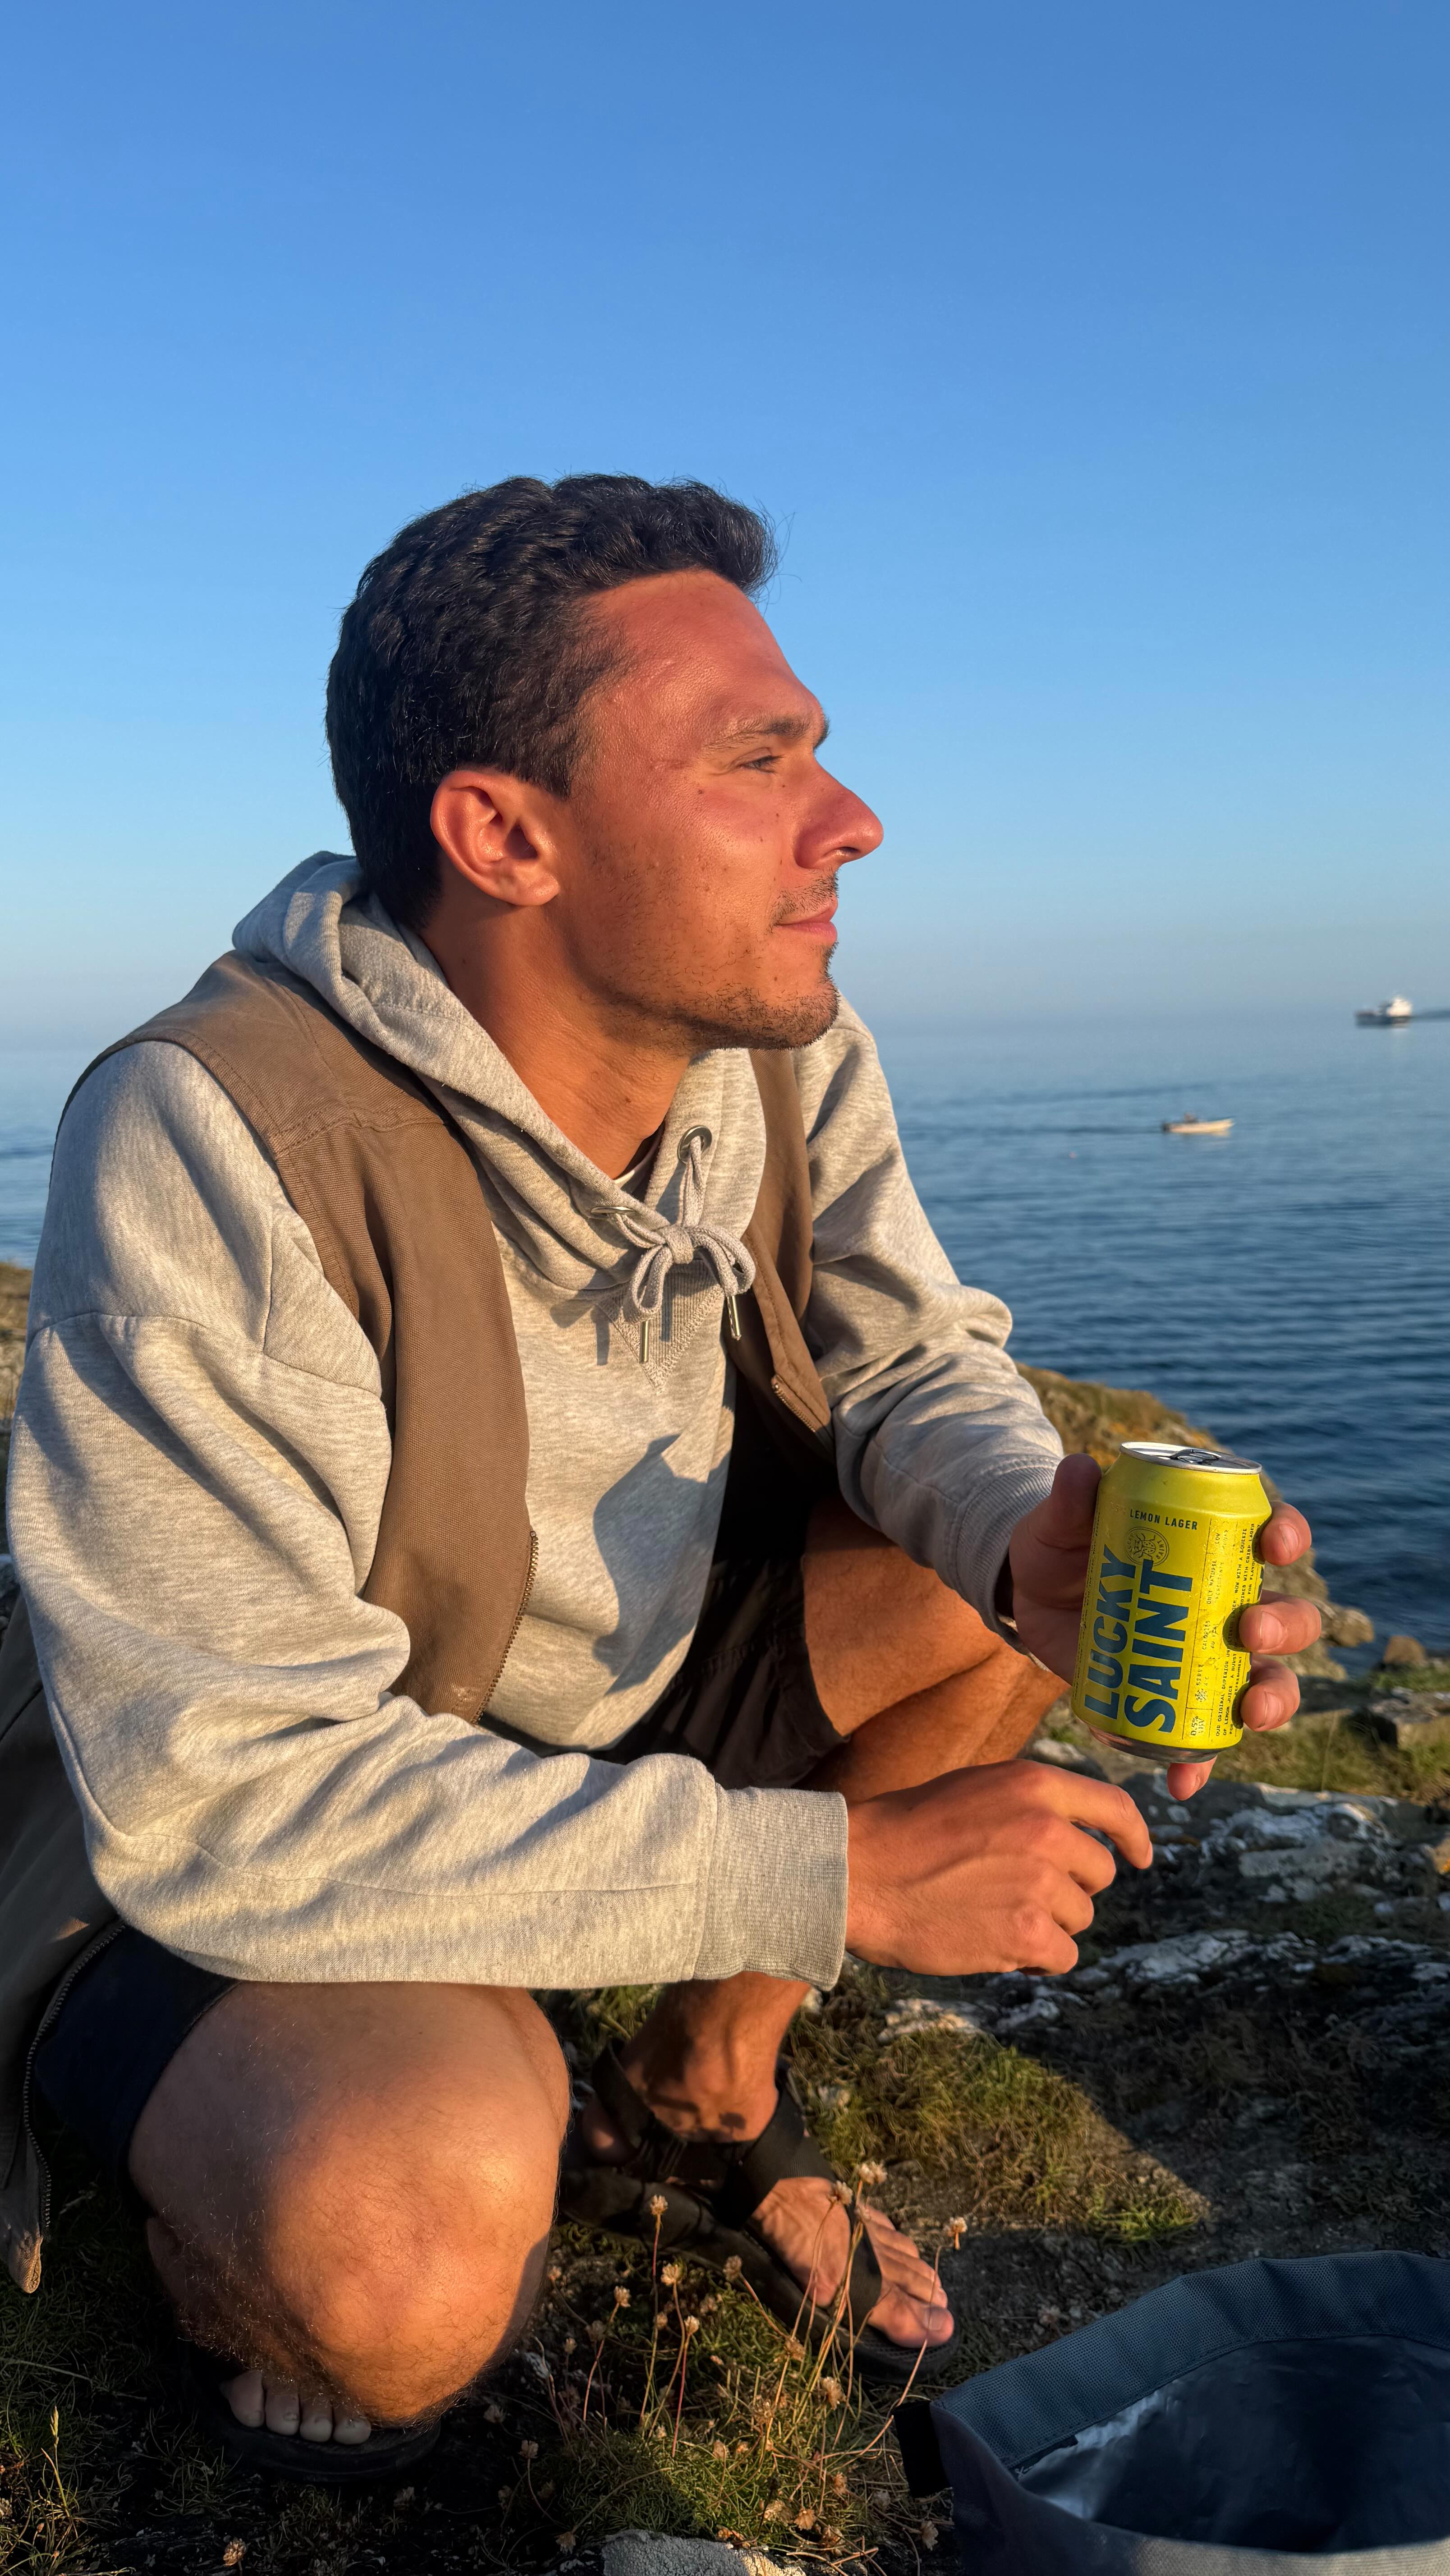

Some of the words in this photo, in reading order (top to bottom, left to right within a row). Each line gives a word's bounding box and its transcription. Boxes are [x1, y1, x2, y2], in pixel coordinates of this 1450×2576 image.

[1130, 1509, 1161, 1523] LEMON
[1165, 1517, 1198, 1530] LAGER
[1084, 1544, 1136, 1720] LUCKY
[1124, 1559, 1193, 1732] SAINT
[1221, 1661, 1229, 1689] SUPERIOR
